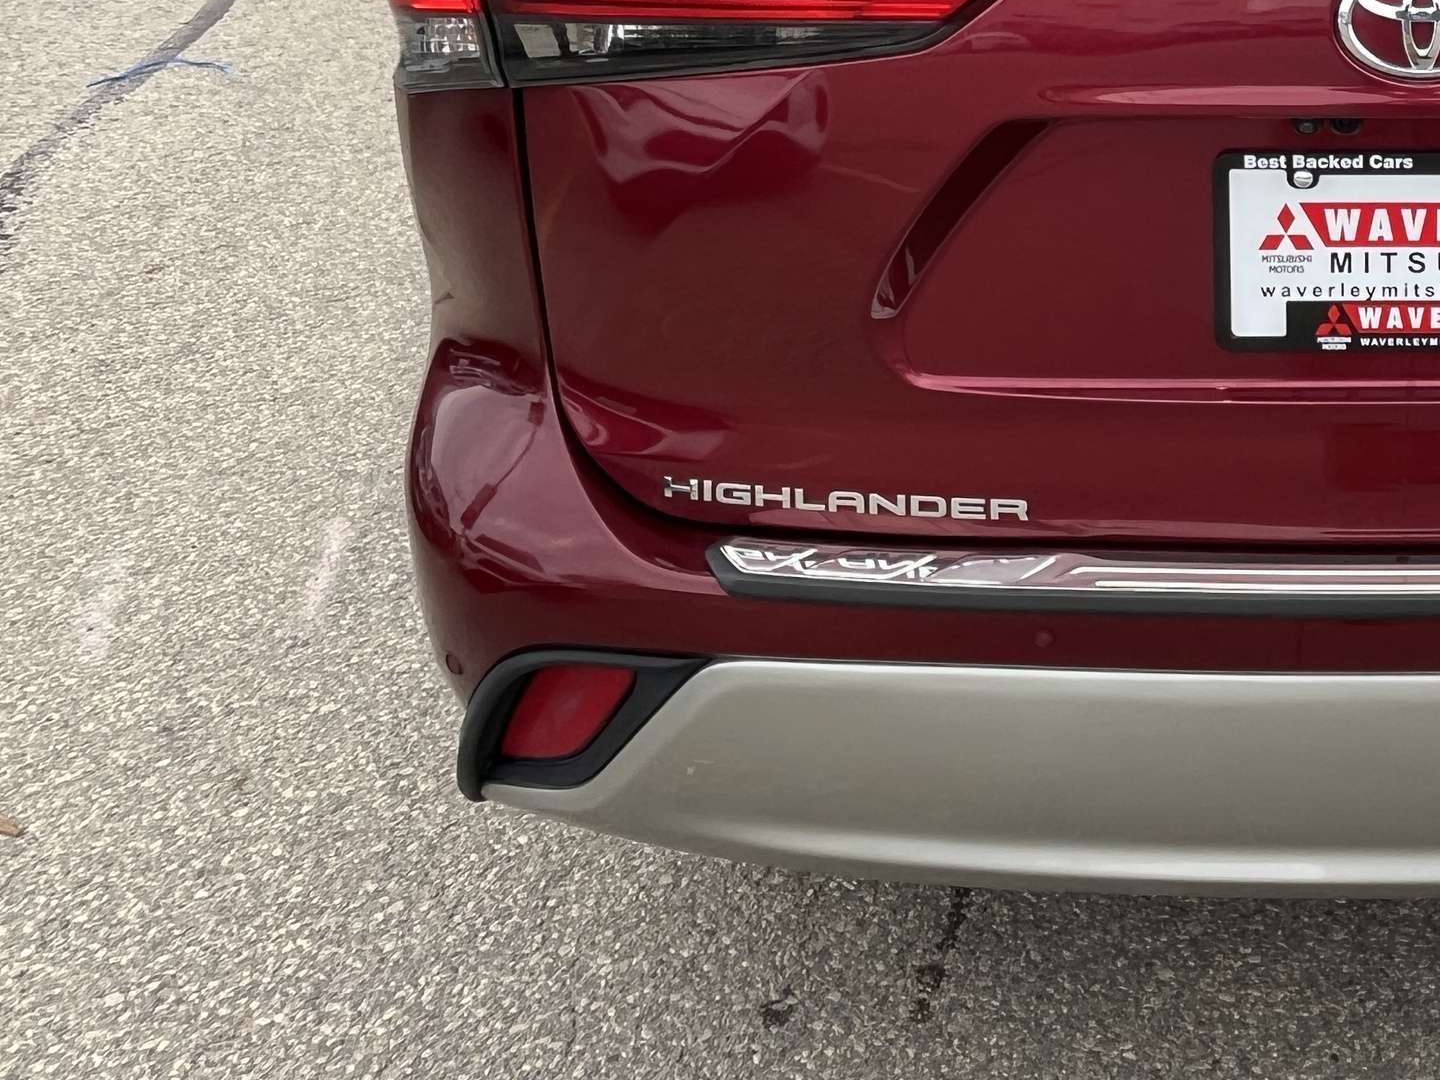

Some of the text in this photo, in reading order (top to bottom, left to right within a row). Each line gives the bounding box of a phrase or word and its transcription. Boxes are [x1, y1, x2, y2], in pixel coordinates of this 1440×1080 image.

[1243, 155, 1414, 169] Best Backed Cars
[1268, 265, 1305, 273] MOTORS
[663, 475, 1029, 522] HIGHLANDER
